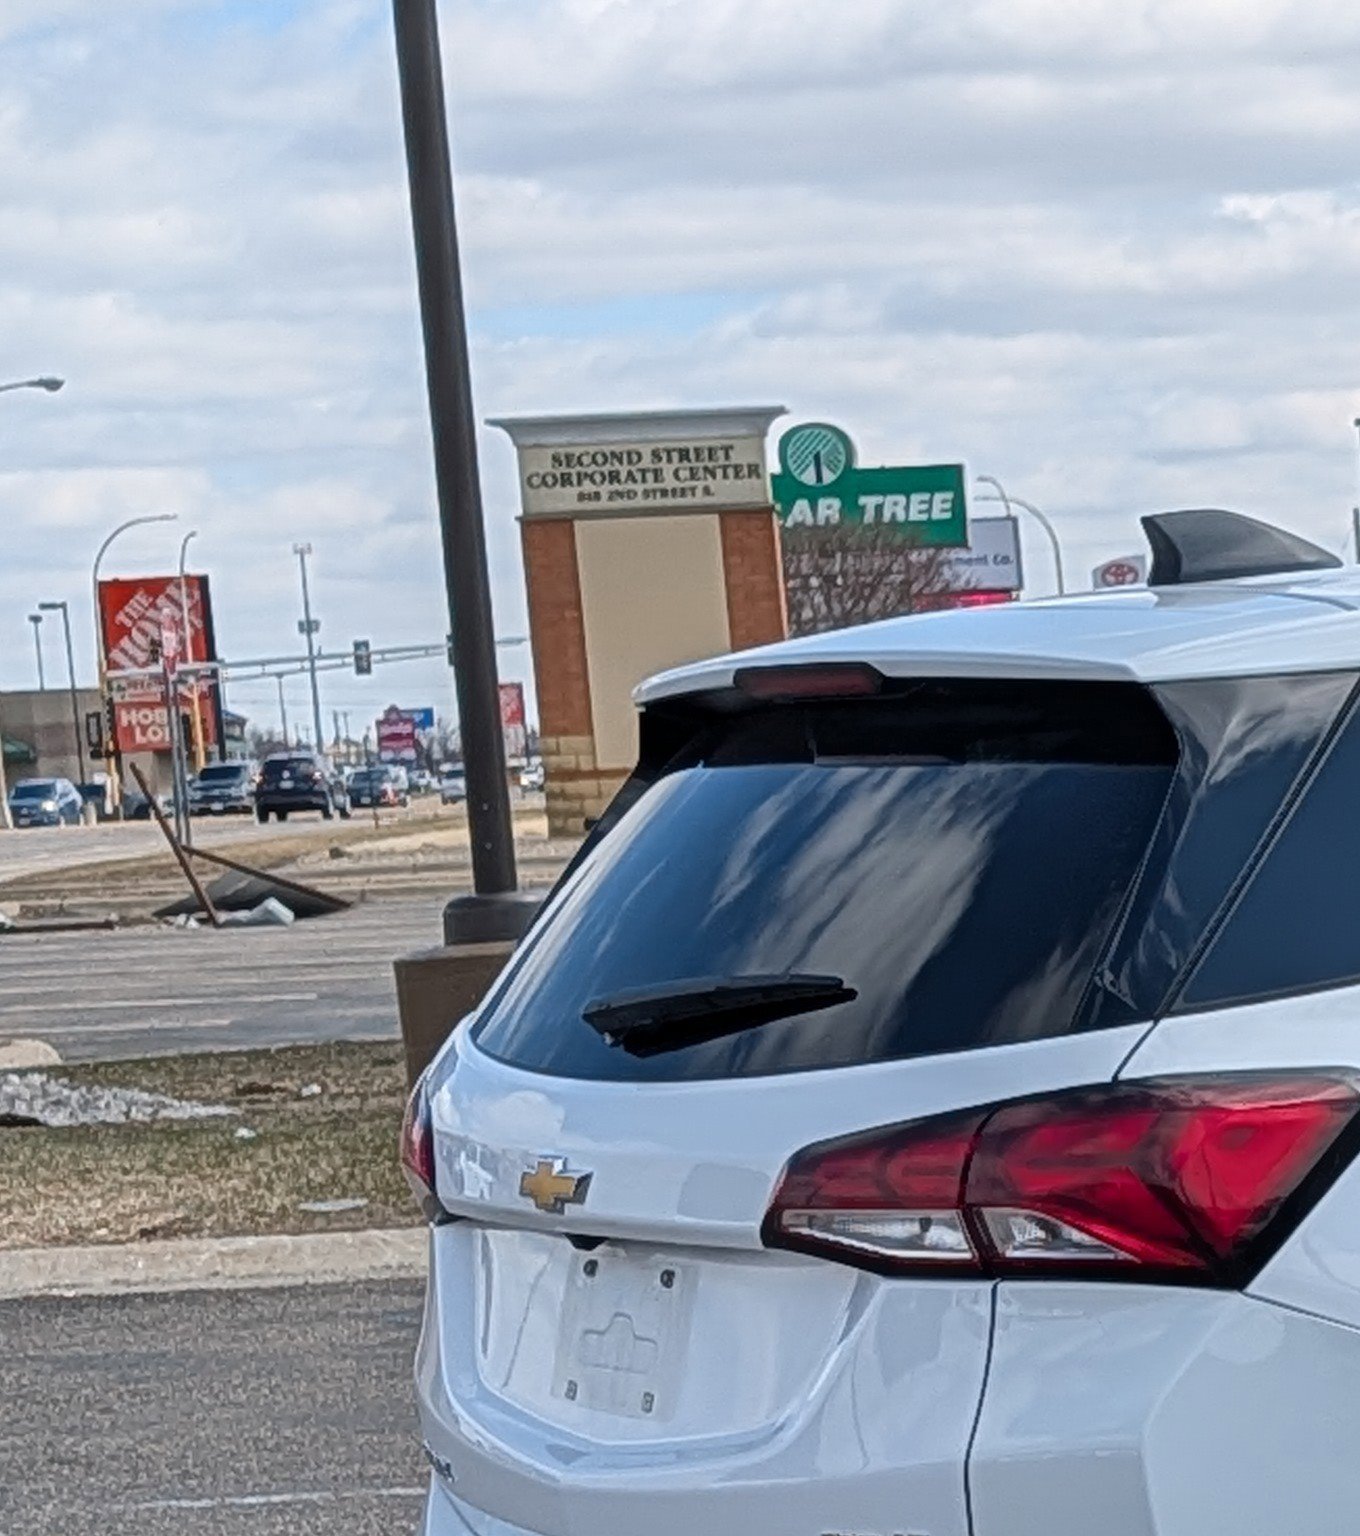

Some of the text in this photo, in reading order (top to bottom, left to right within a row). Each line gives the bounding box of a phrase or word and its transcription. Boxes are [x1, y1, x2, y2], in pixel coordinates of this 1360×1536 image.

[551, 444, 735, 470] SECOND STREET
[526, 462, 762, 490] CORPORATE CENTER
[641, 485, 698, 500] STREET
[774, 491, 955, 528] AR TREE
[115, 586, 155, 628] THE
